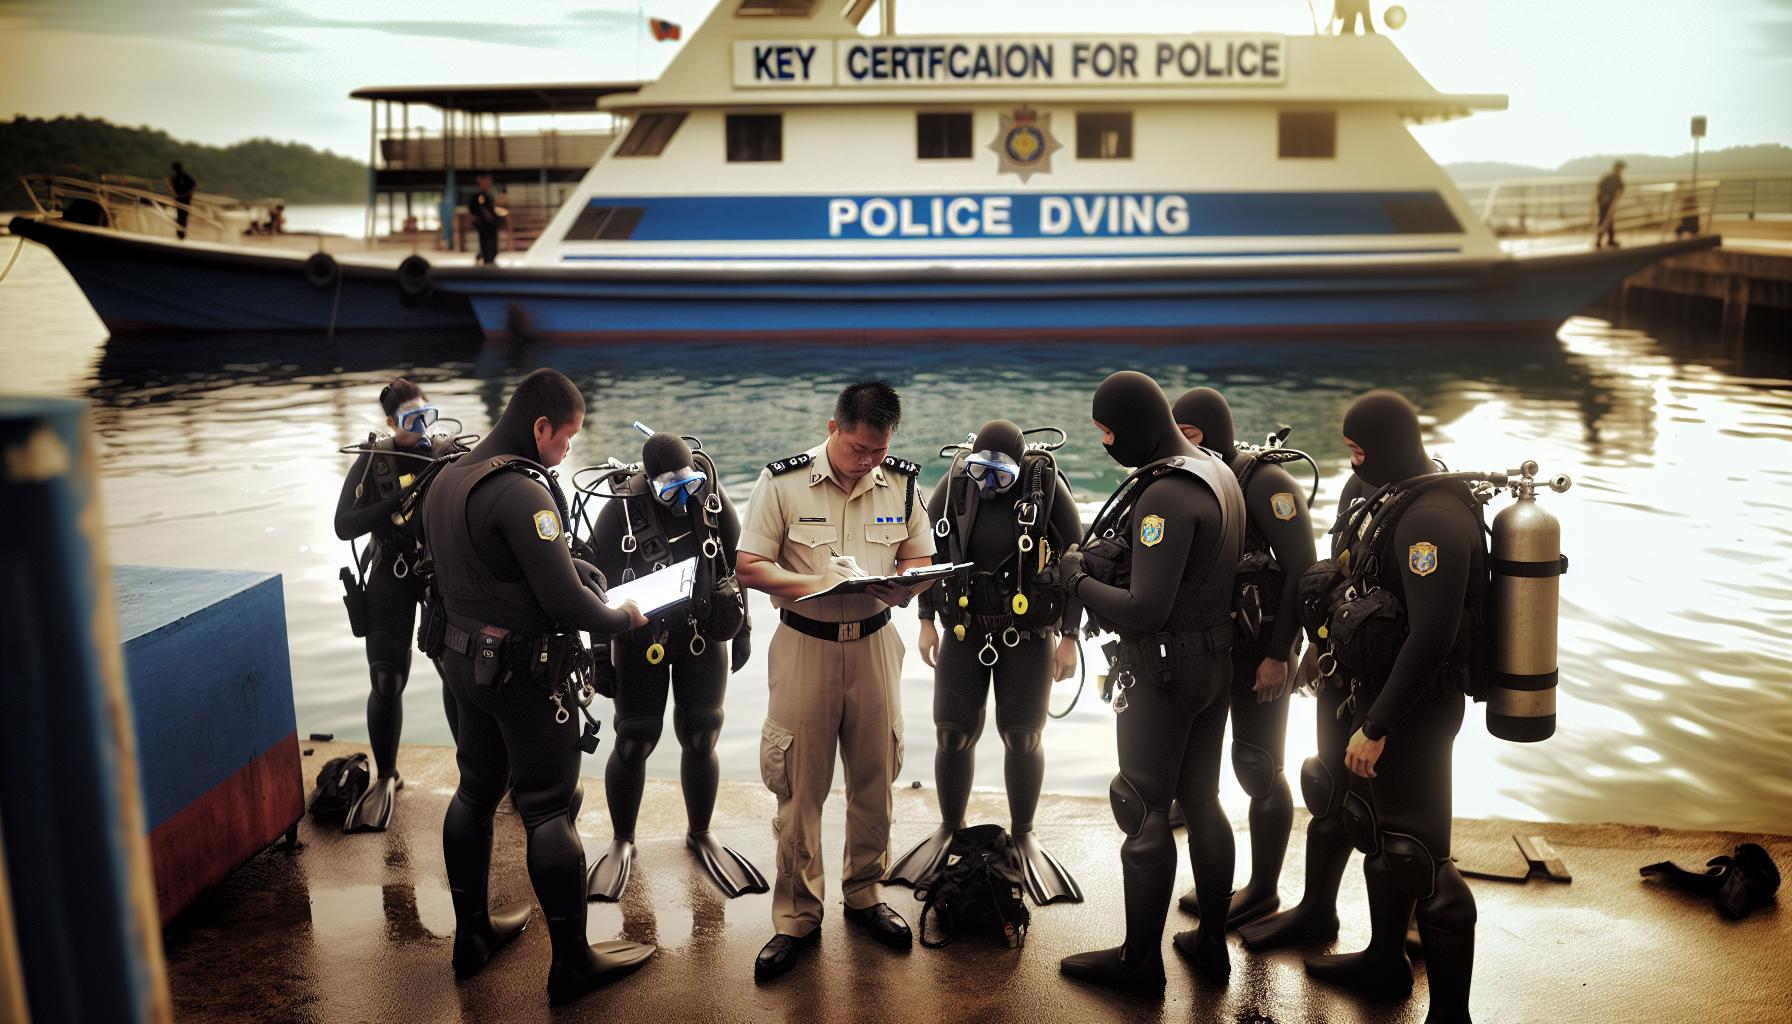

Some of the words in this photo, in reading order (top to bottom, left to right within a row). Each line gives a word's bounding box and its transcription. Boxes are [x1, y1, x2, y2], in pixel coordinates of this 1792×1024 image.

[752, 44, 815, 80] KEY
[1071, 42, 1137, 78] FOR
[1154, 40, 1279, 77] POLICE
[828, 197, 1012, 237] POLICE
[1038, 194, 1190, 235] DVING
